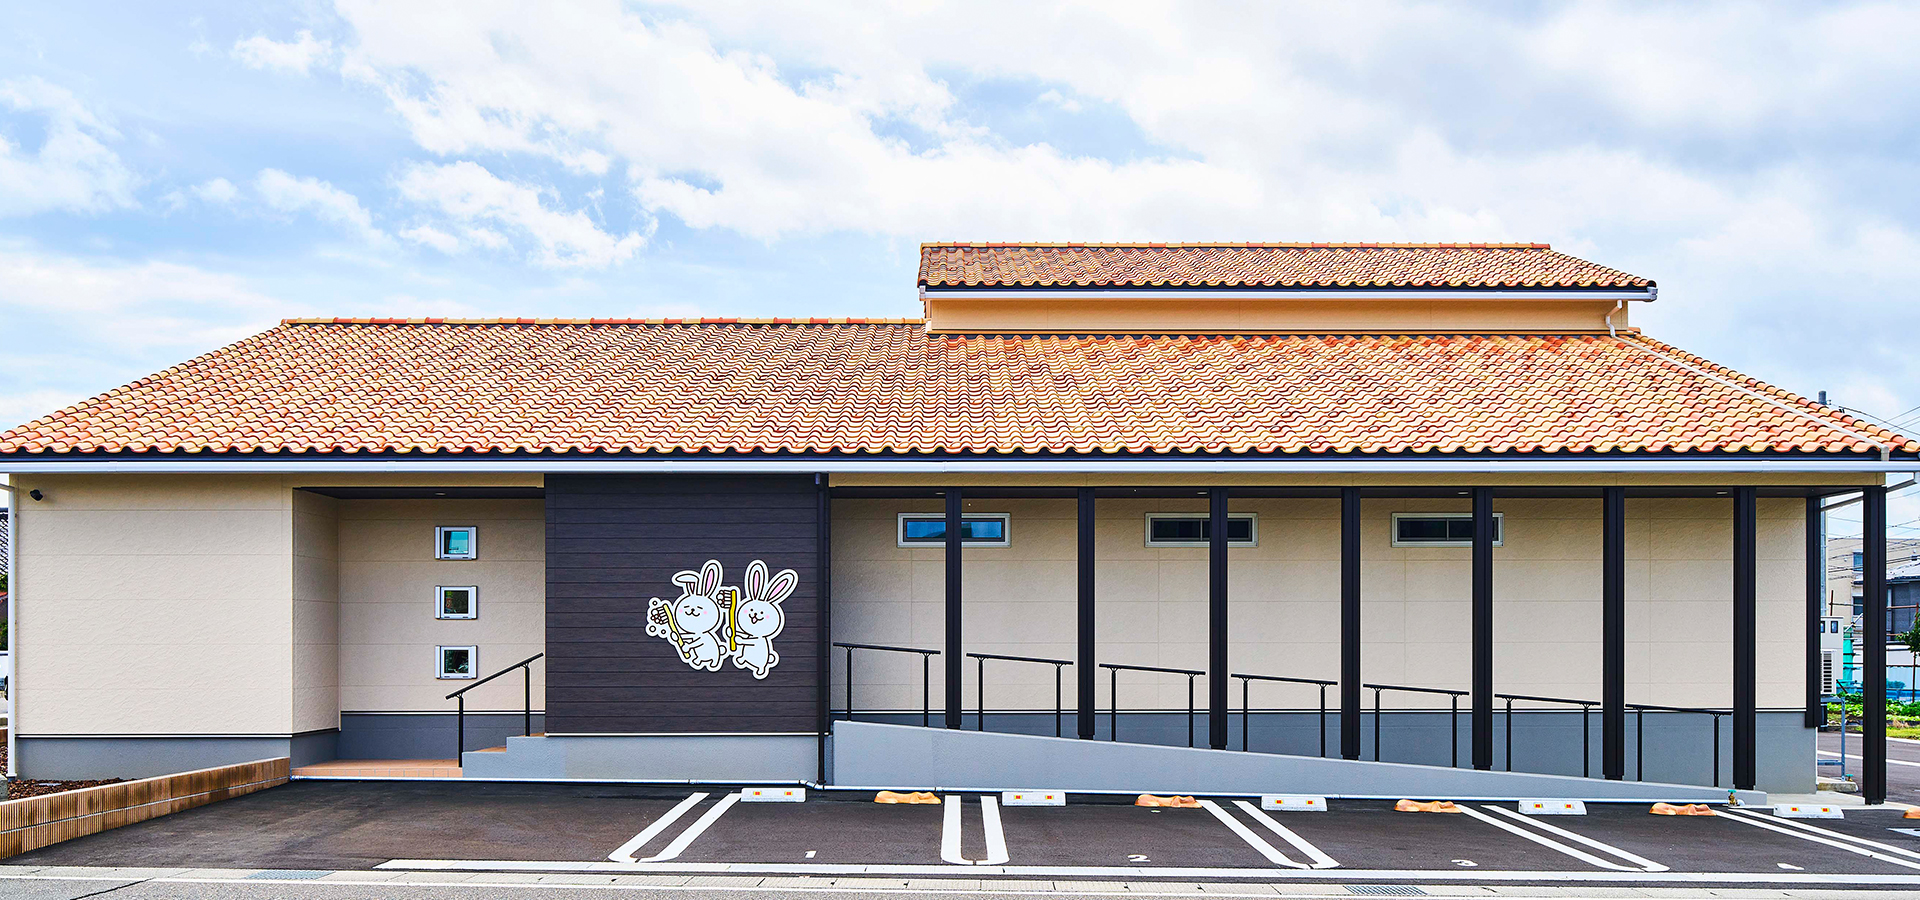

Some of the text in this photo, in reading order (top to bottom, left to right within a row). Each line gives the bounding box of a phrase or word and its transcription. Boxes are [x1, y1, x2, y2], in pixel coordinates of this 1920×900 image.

[805, 850, 817, 858] 1
[1128, 854, 1151, 862] 2
[1451, 859, 1478, 867] 3
